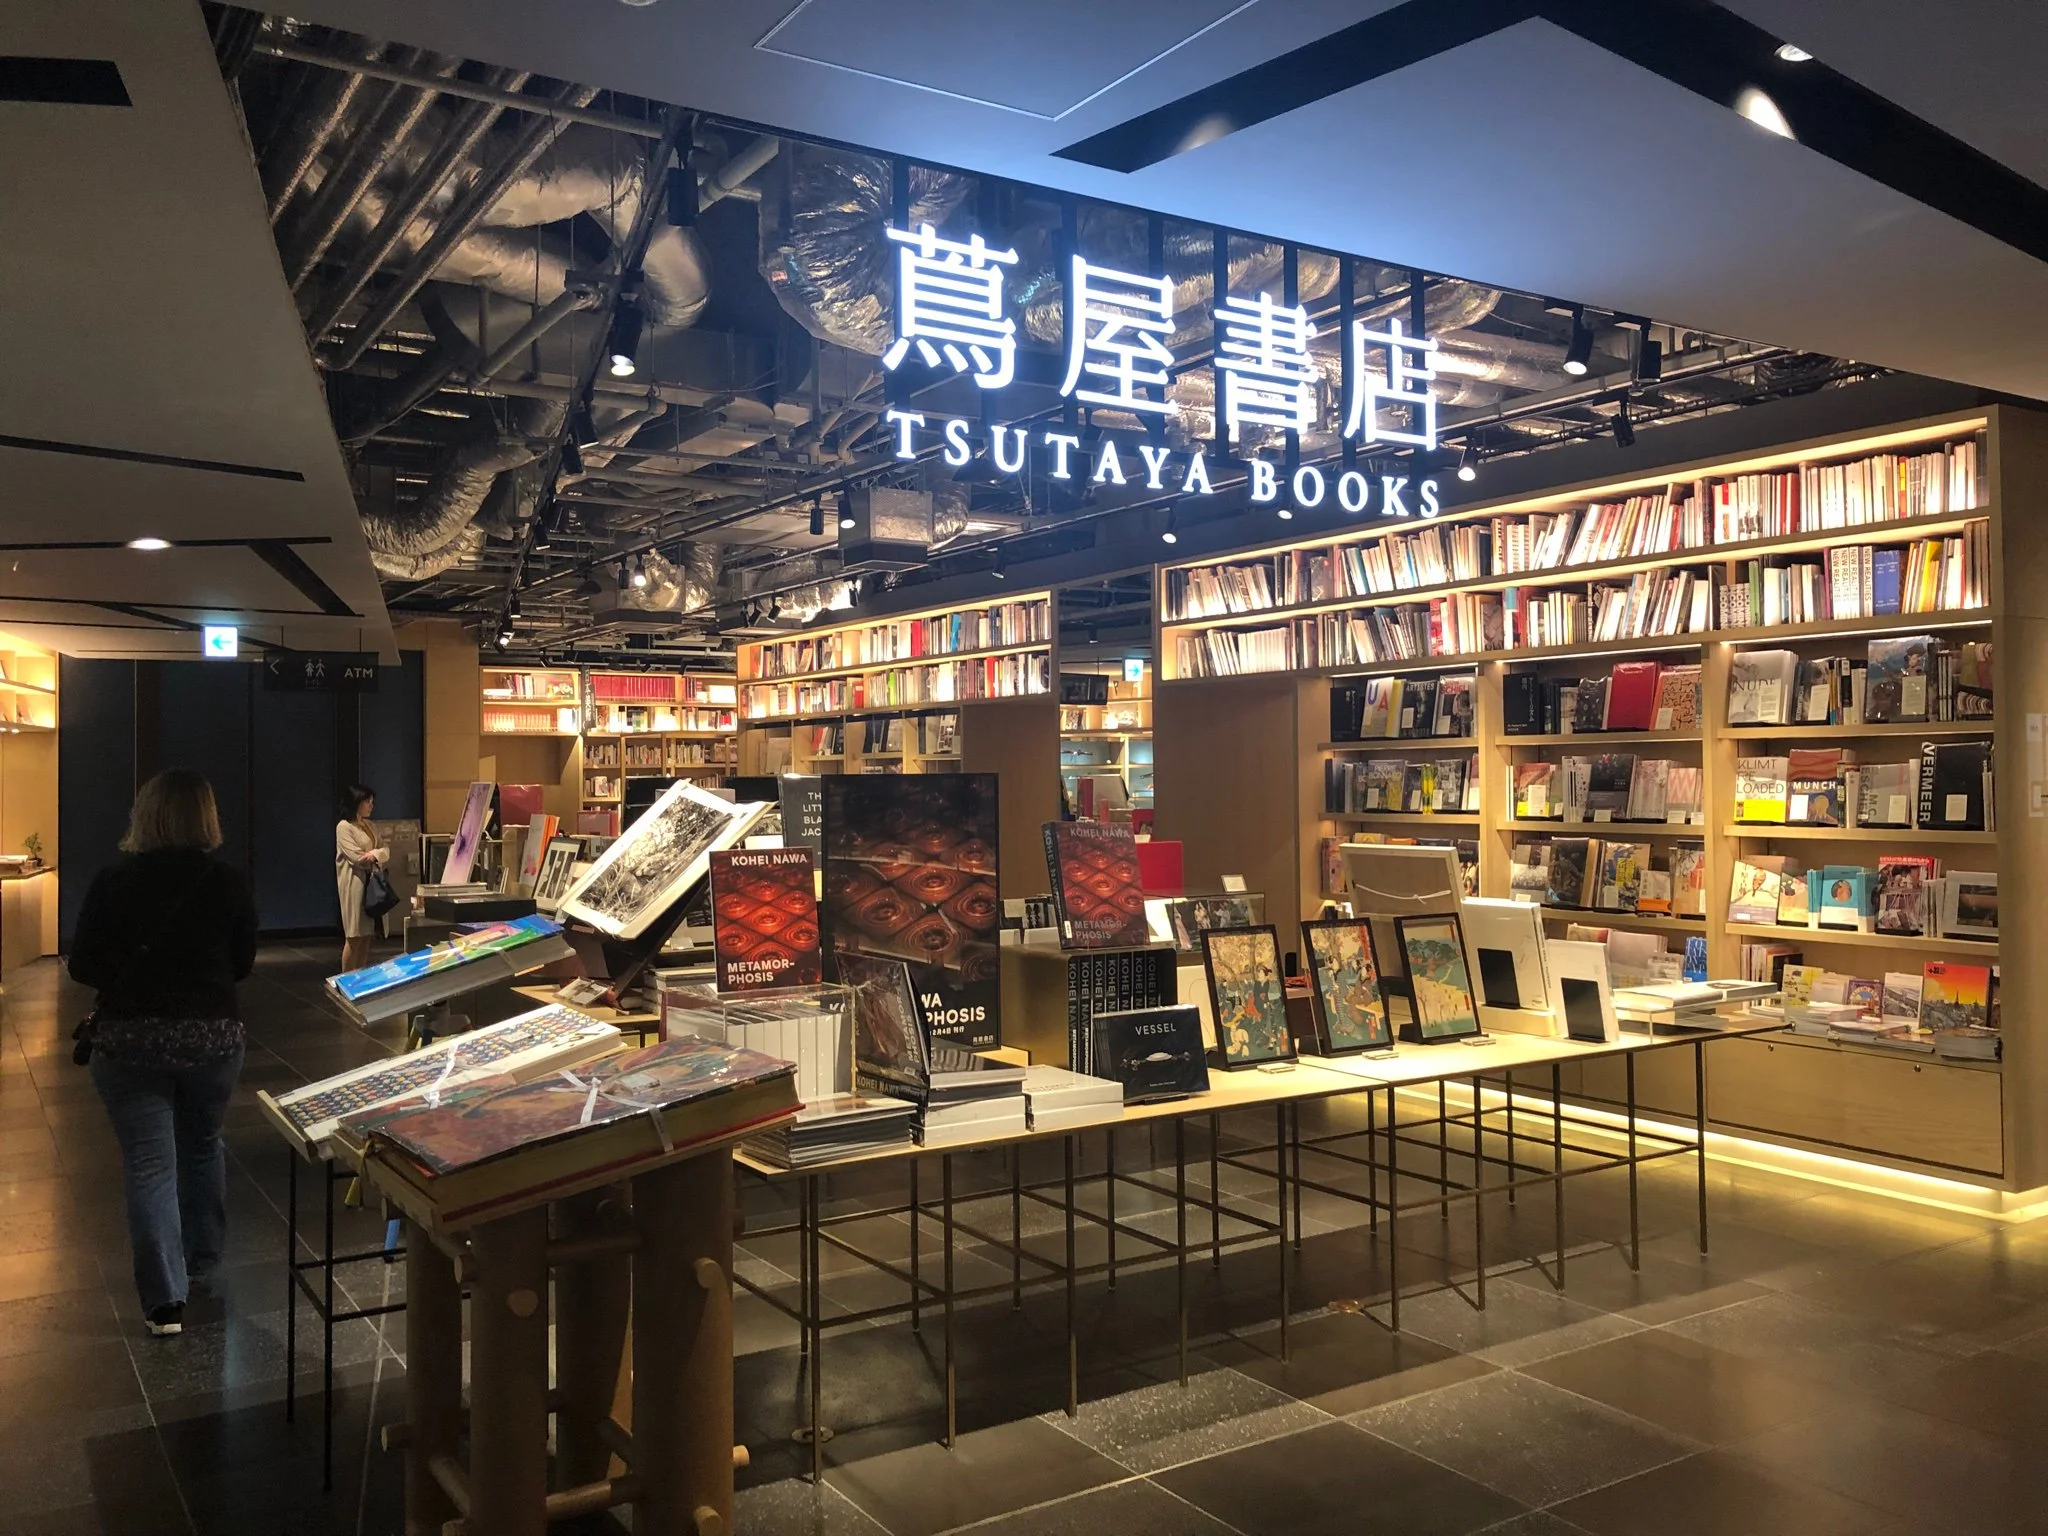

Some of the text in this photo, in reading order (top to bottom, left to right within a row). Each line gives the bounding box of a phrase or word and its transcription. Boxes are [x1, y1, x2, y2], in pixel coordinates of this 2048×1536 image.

[883, 223, 1440, 452] 蔦屋書店
[886, 409, 1440, 518] TSUTAYA BOOKS
[344, 667, 374, 678] ATM
[1738, 759, 1777, 770] KLIMT
[1736, 783, 1784, 794] LOADED
[1793, 781, 1836, 790] MUNCH
[1920, 745, 1935, 822] VERMEER
[1070, 826, 1130, 838] KOHEI NAWA
[731, 853, 808, 867] KOHEI NAWA
[1074, 930, 1112, 940] PHOSIS
[727, 958, 796, 973] METAMOR-
[728, 971, 774, 985] PHOSIS
[1068, 963, 1077, 1001] KOHEI
[1081, 962, 1090, 1000] KOHEI
[1095, 960, 1103, 998] KOHEI
[1108, 959, 1116, 997] KOHEI
[1121, 958, 1130, 995] KOHEI
[1135, 957, 1143, 994] KOHEI
[1134, 1023, 1177, 1036] VESSEL
